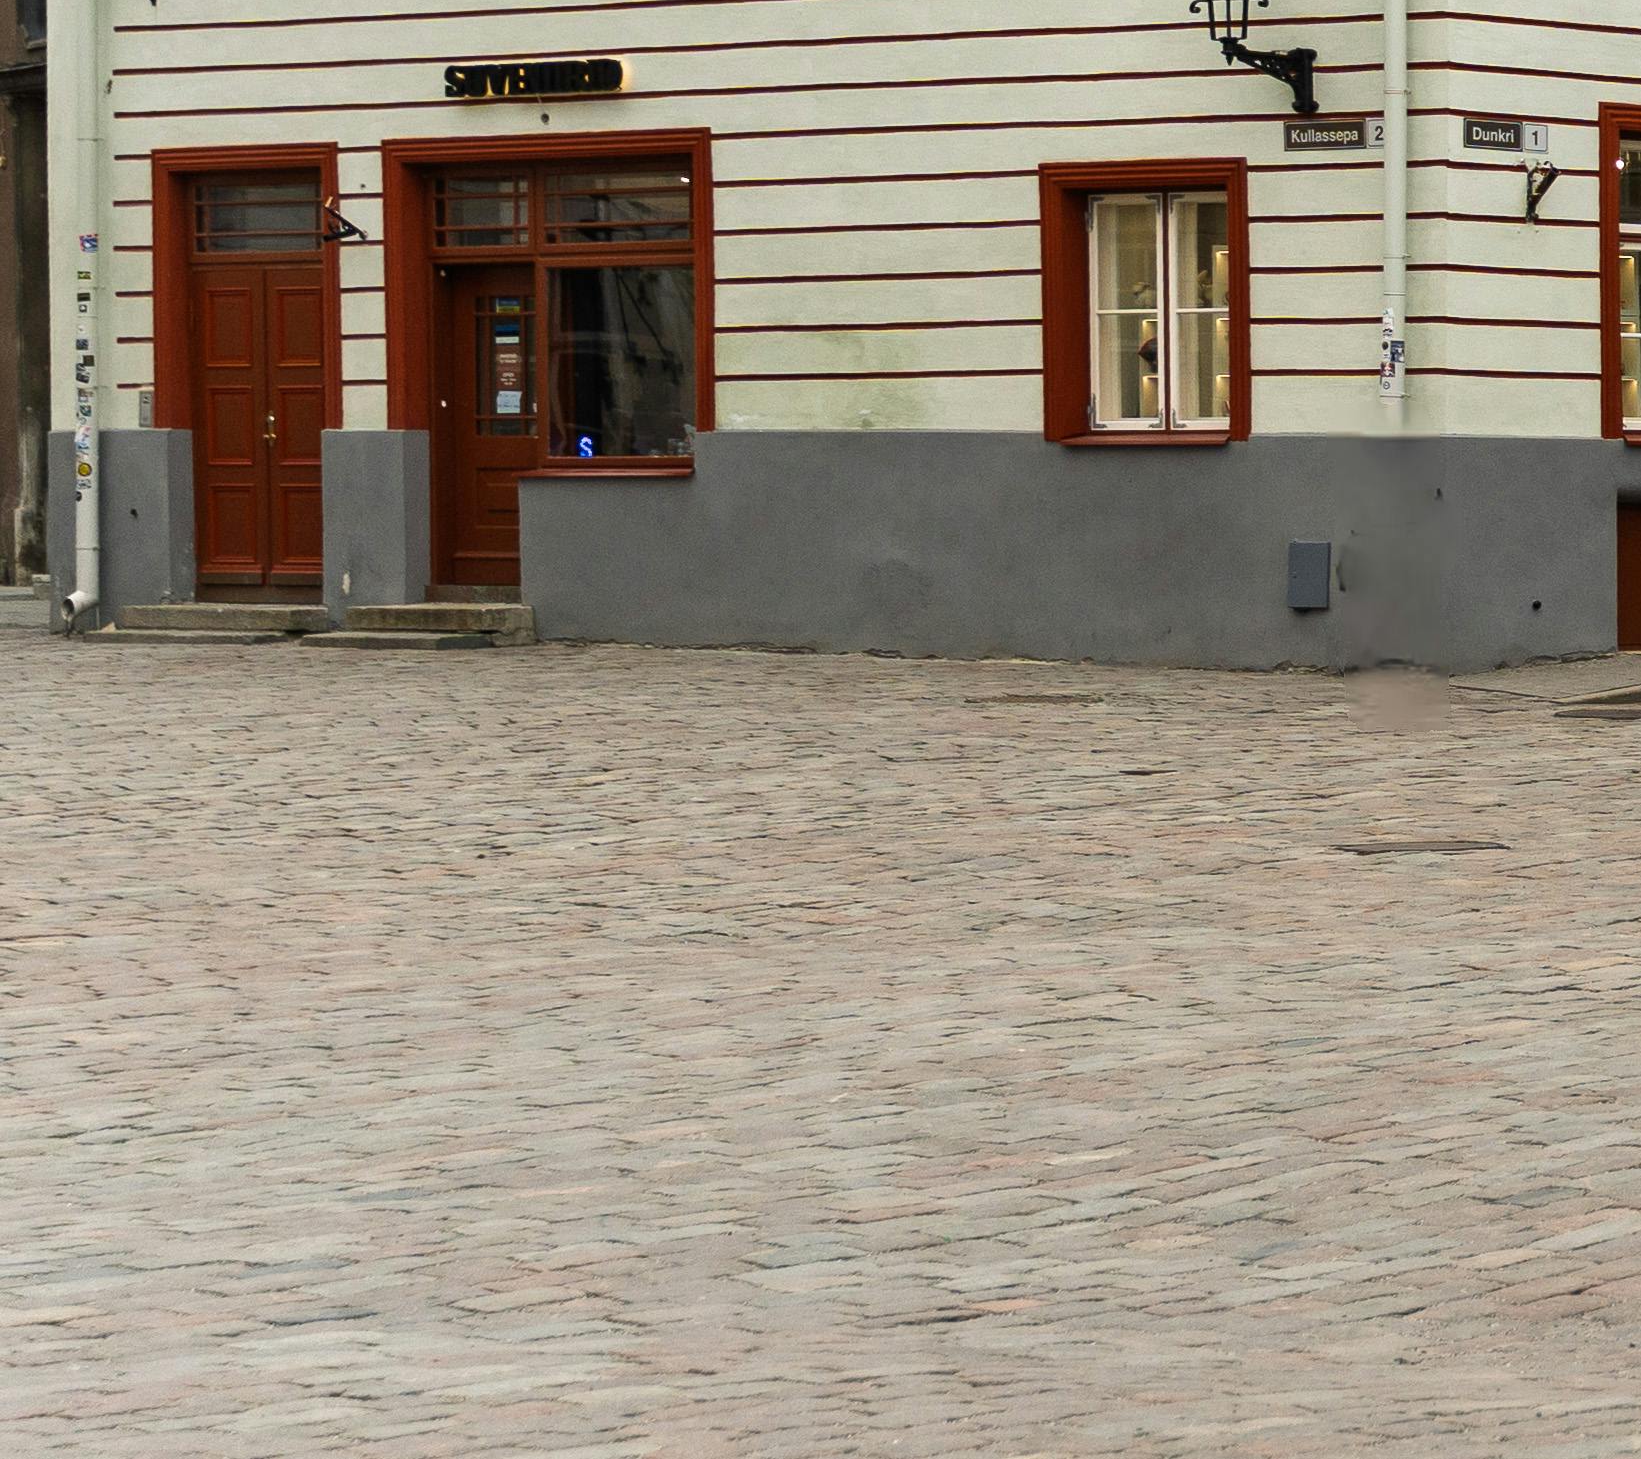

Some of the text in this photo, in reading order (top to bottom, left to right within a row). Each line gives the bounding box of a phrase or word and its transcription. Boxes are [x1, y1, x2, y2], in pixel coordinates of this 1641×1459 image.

[1291, 129, 1359, 145] Kullassepa
[1472, 127, 1515, 143] Dunkri
[1532, 130, 1539, 147] 1
